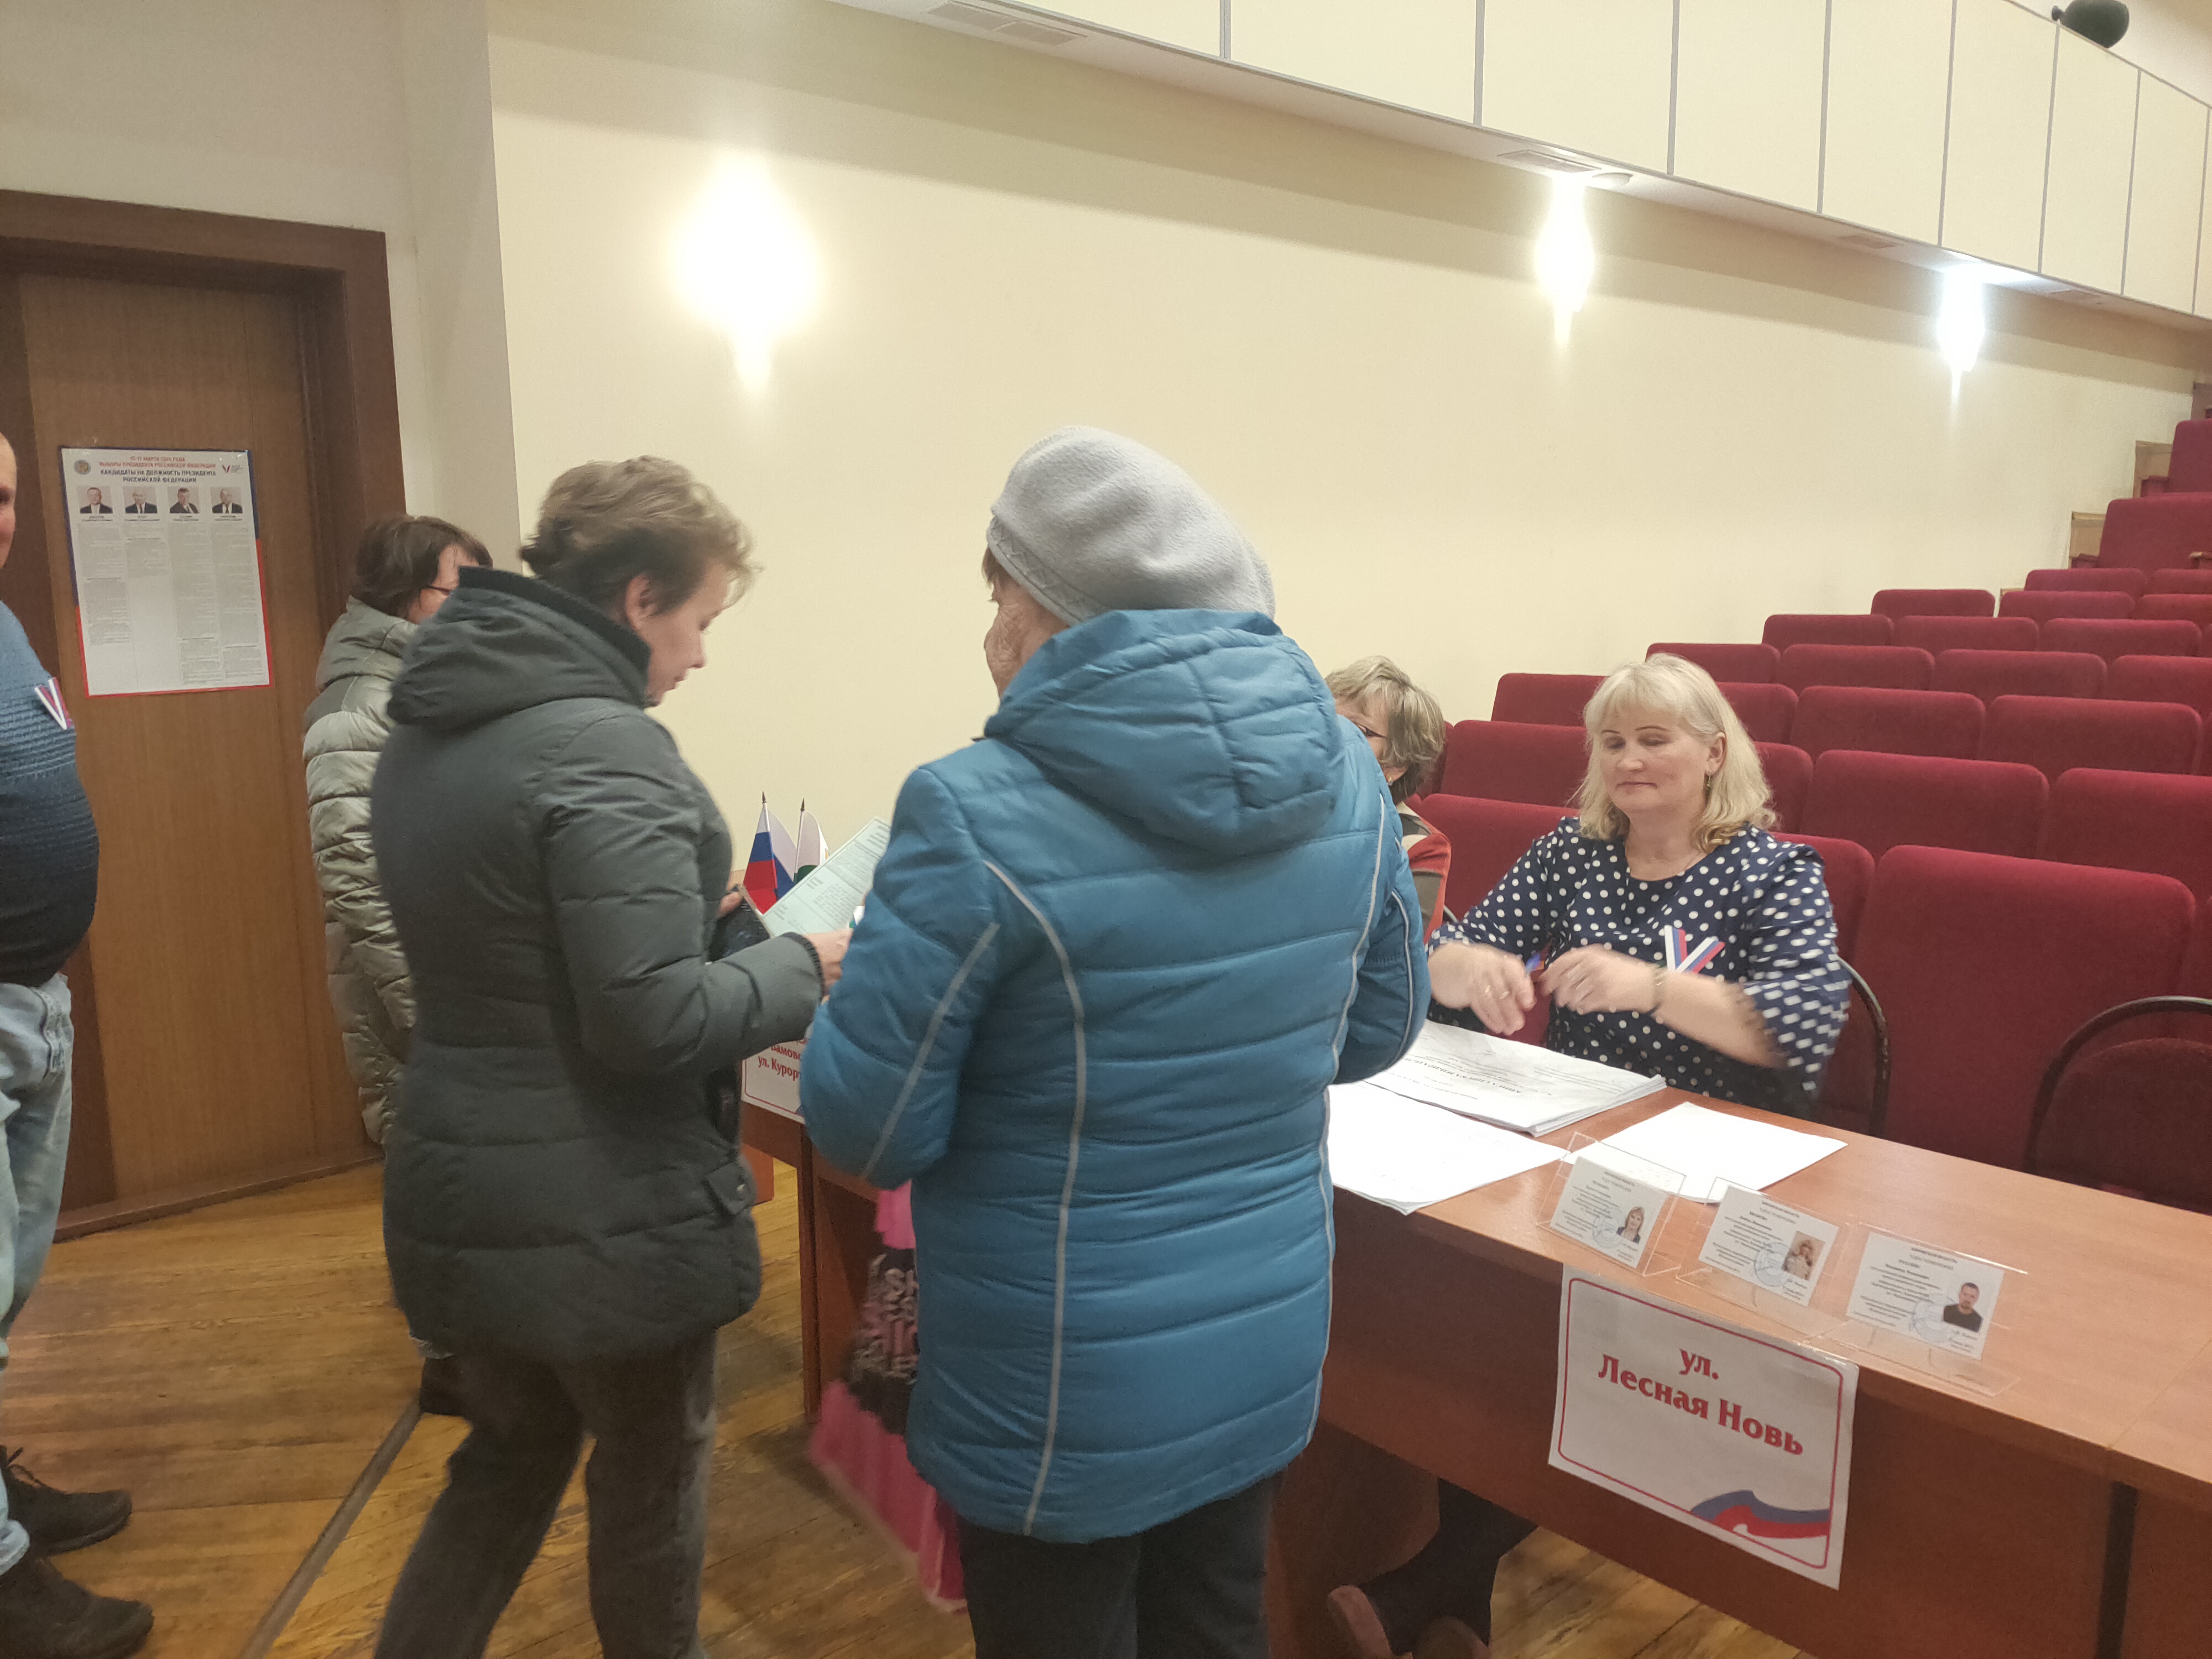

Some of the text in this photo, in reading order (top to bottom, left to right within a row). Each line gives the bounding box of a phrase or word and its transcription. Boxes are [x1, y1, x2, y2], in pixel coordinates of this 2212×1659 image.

[758, 1056, 800, 1082] ул. Курор
[1679, 1348, 1719, 1380] ул.
[1598, 1354, 1803, 1455] Лесная Новь
